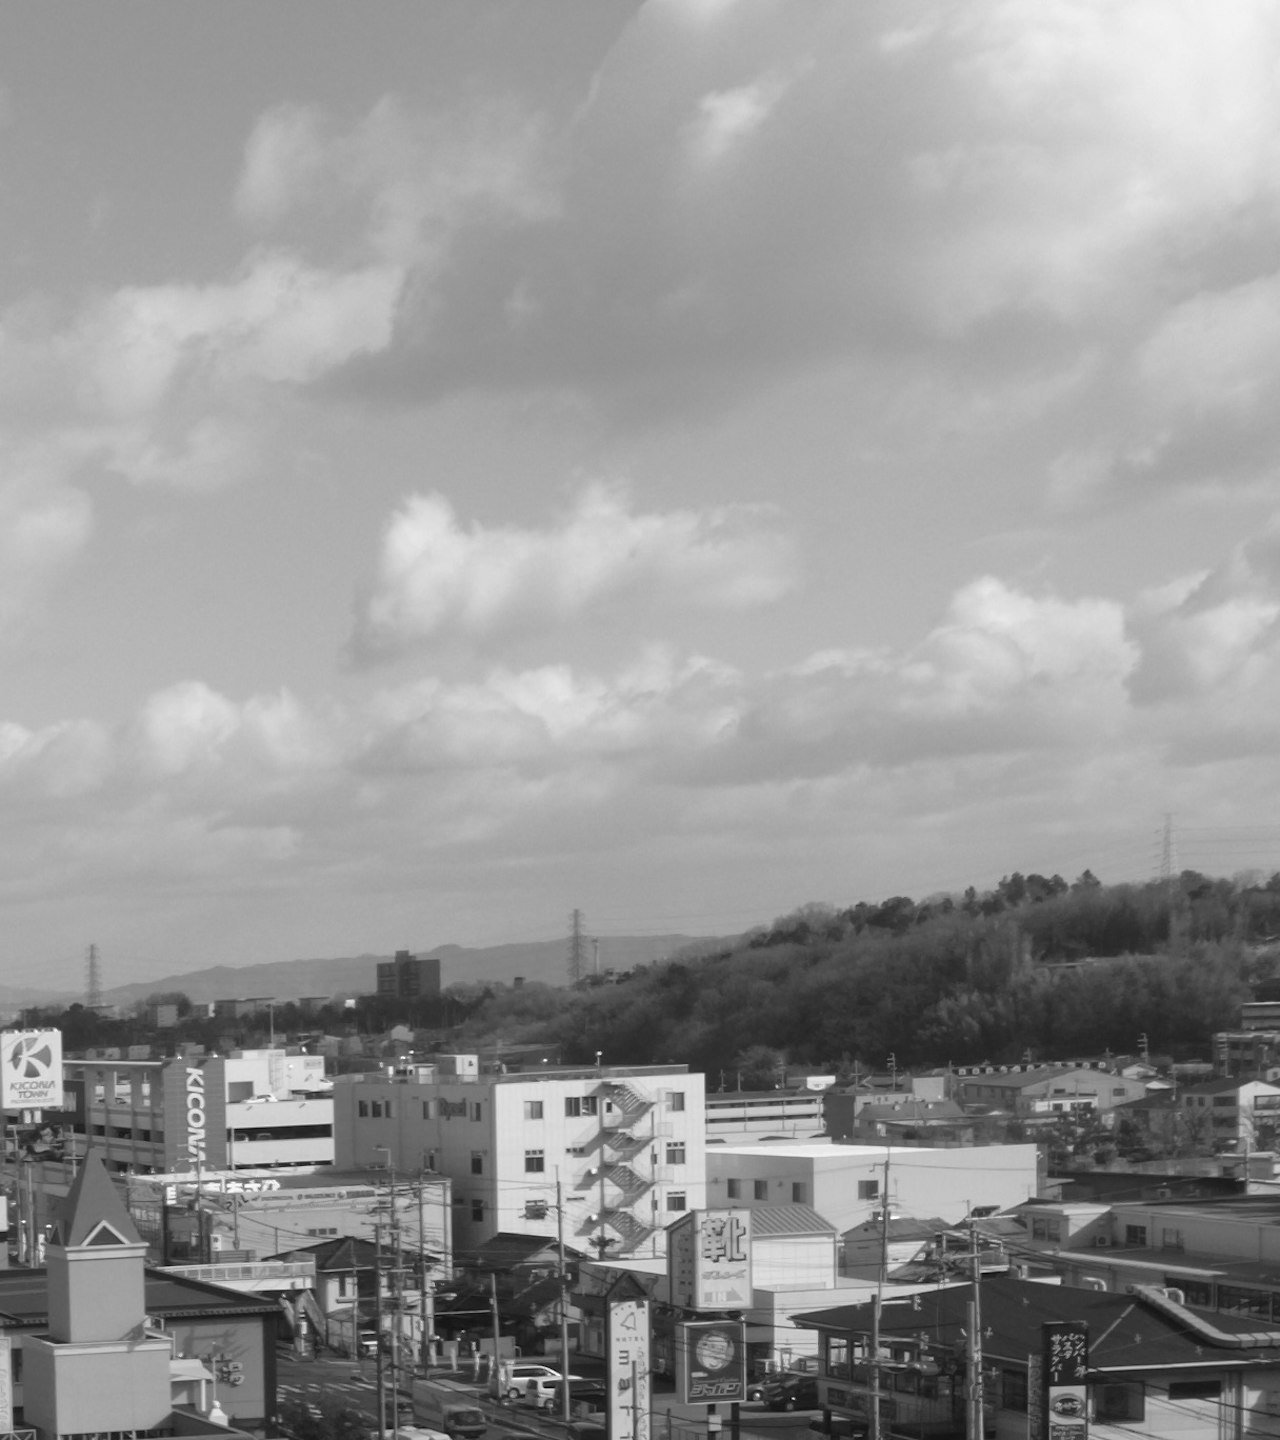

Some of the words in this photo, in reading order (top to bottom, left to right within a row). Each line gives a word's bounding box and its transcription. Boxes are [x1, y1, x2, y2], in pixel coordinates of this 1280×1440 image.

[10, 1080, 56, 1091] KICONA
[18, 1090, 49, 1099] TOWN
[185, 1067, 207, 1163] KICONA
[701, 1217, 747, 1263] 靴
